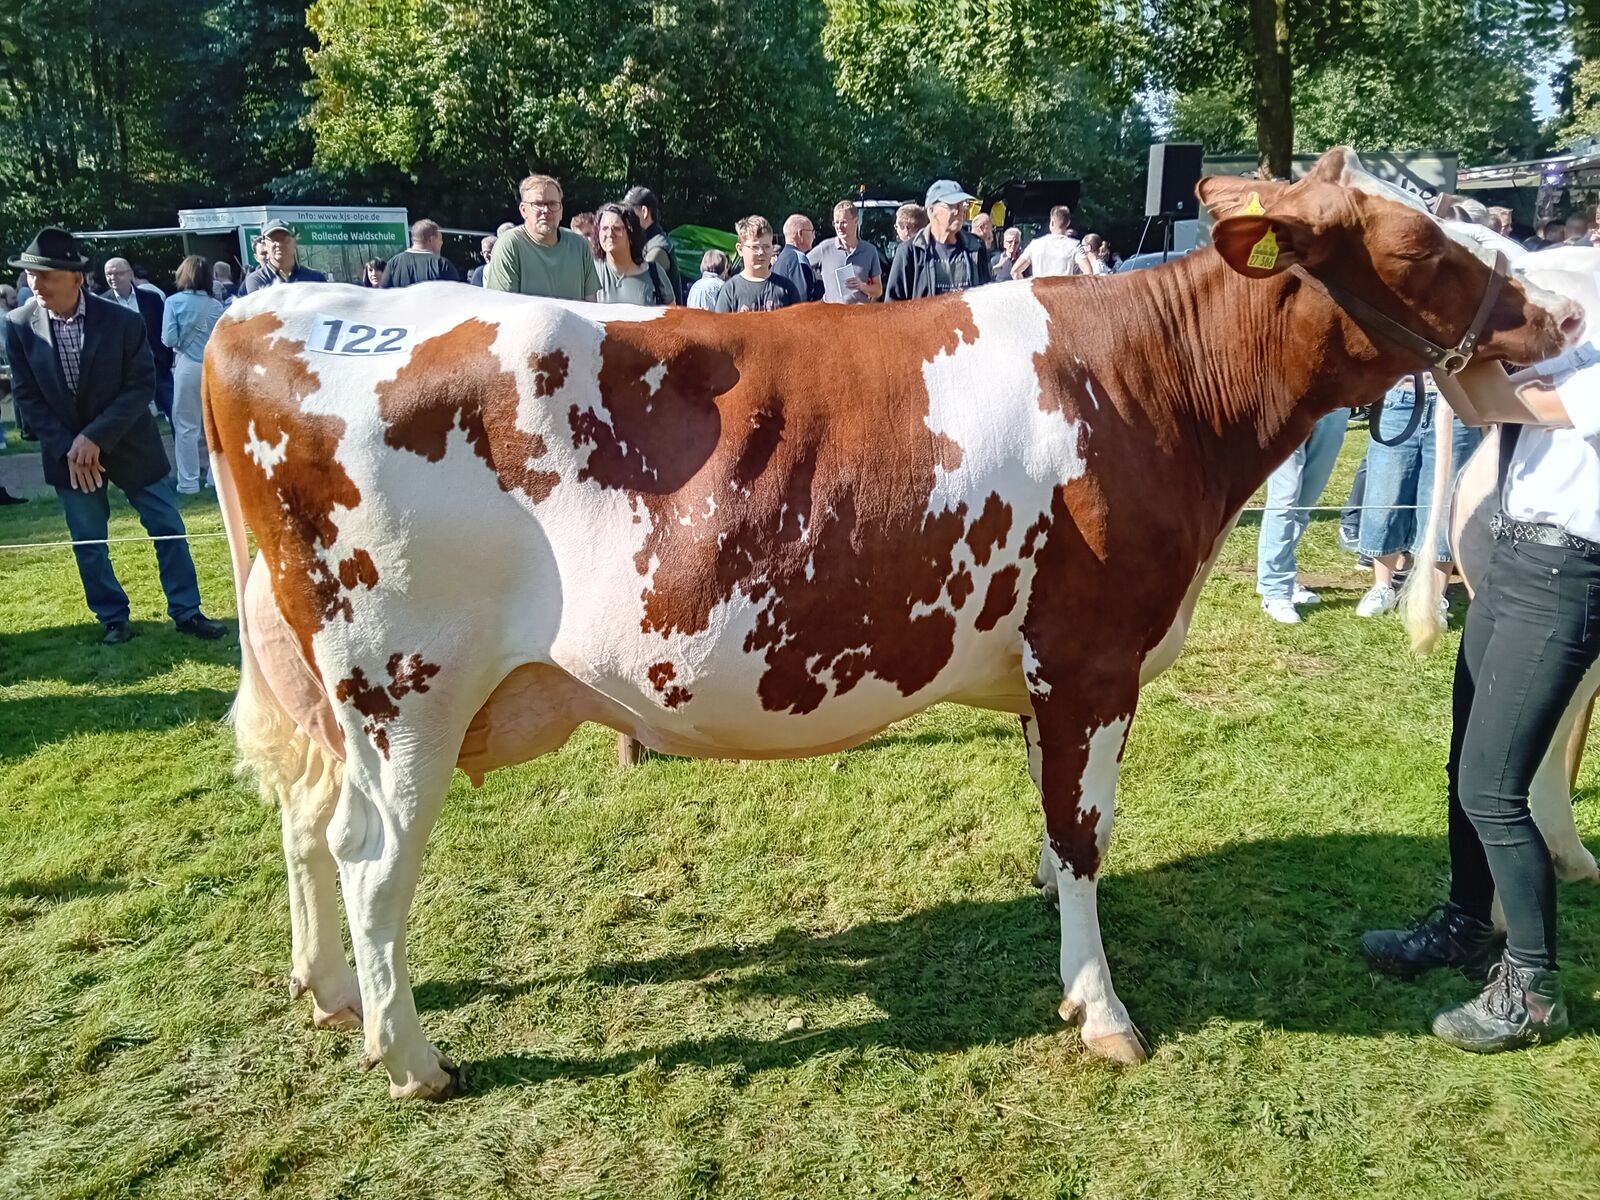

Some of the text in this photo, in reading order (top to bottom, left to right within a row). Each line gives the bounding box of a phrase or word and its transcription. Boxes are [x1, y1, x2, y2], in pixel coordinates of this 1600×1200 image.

[298, 212, 380, 222] Info: www.kjs-olpe.de
[311, 231, 396, 241] Rollende Waldschule
[322, 319, 408, 353] 122
